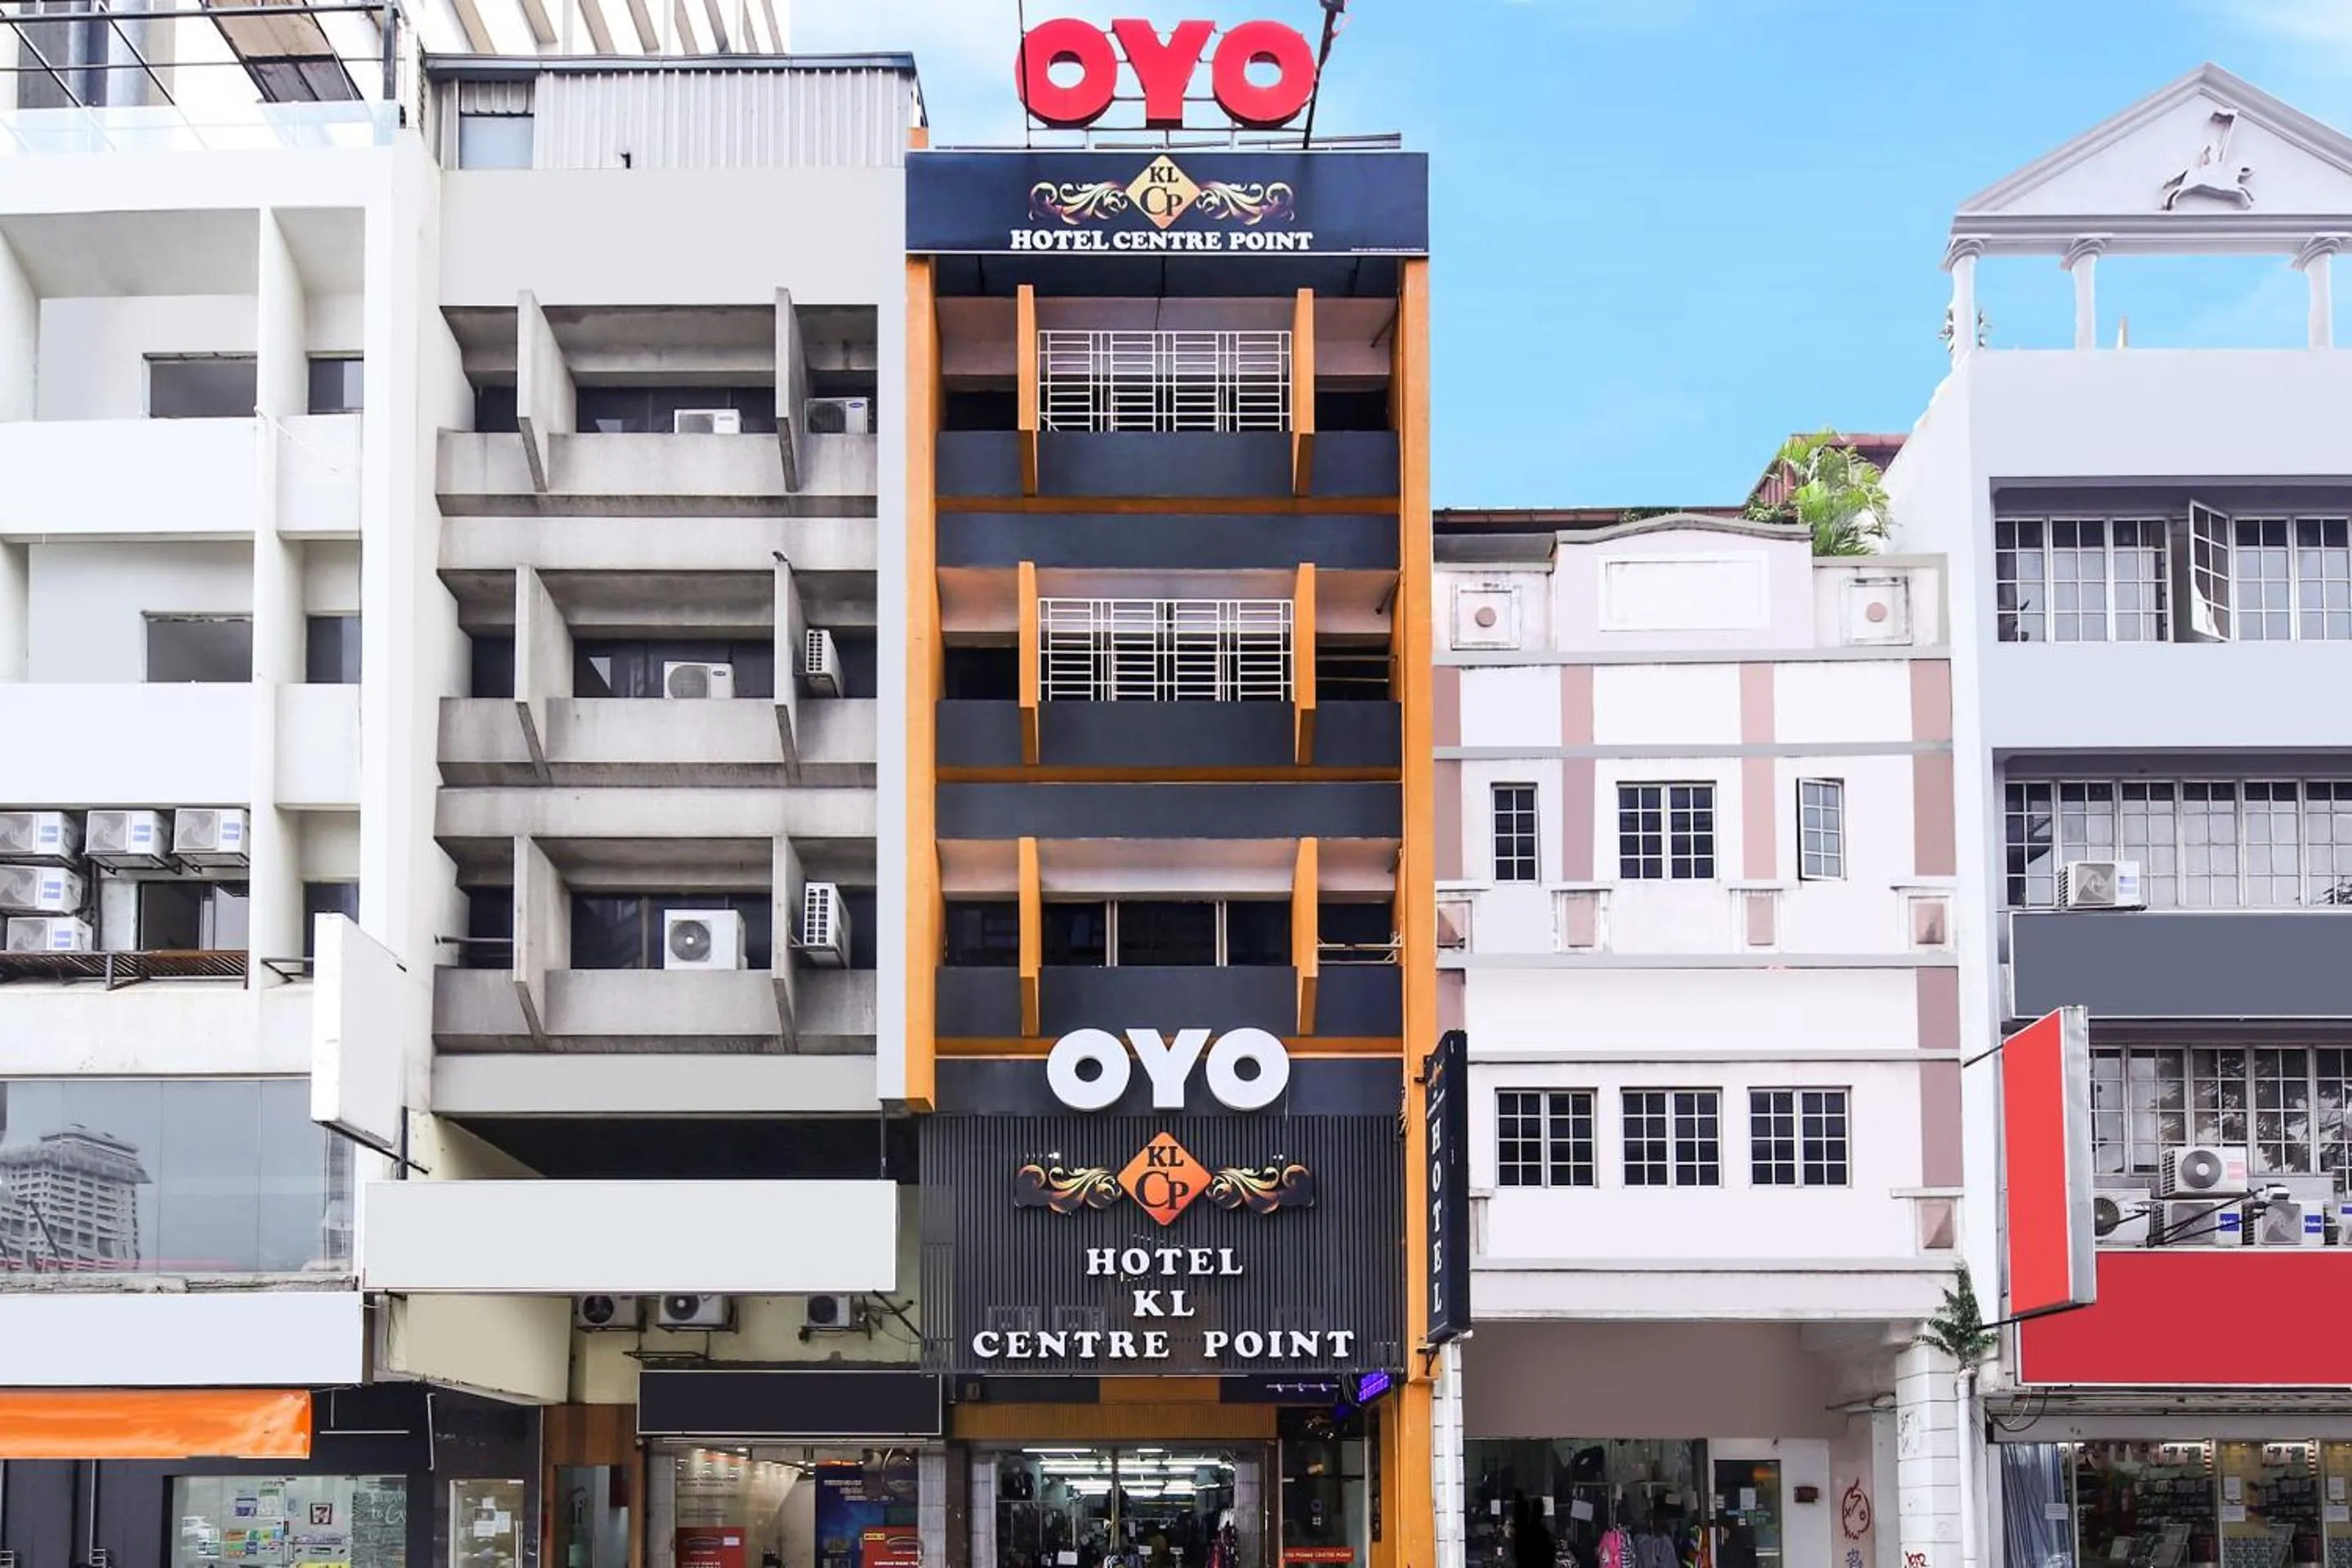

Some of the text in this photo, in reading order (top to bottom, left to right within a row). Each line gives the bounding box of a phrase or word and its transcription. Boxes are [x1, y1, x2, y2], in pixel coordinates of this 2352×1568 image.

[1015, 18, 1317, 129] OYO
[1149, 166, 1178, 183] KL
[1139, 185, 1183, 216] CP
[1009, 229, 1313, 250] HOTEL CENTRE POINT
[1046, 1028, 1290, 1111] OYO
[1147, 1146, 1184, 1167] KL
[1135, 1171, 1189, 1209] CP
[1431, 1117, 1442, 1313] HOTEL
[1085, 1248, 1244, 1276] HOTEL
[1133, 1290, 1195, 1317] KL
[972, 1331, 1354, 1359] CENTRE POINT
